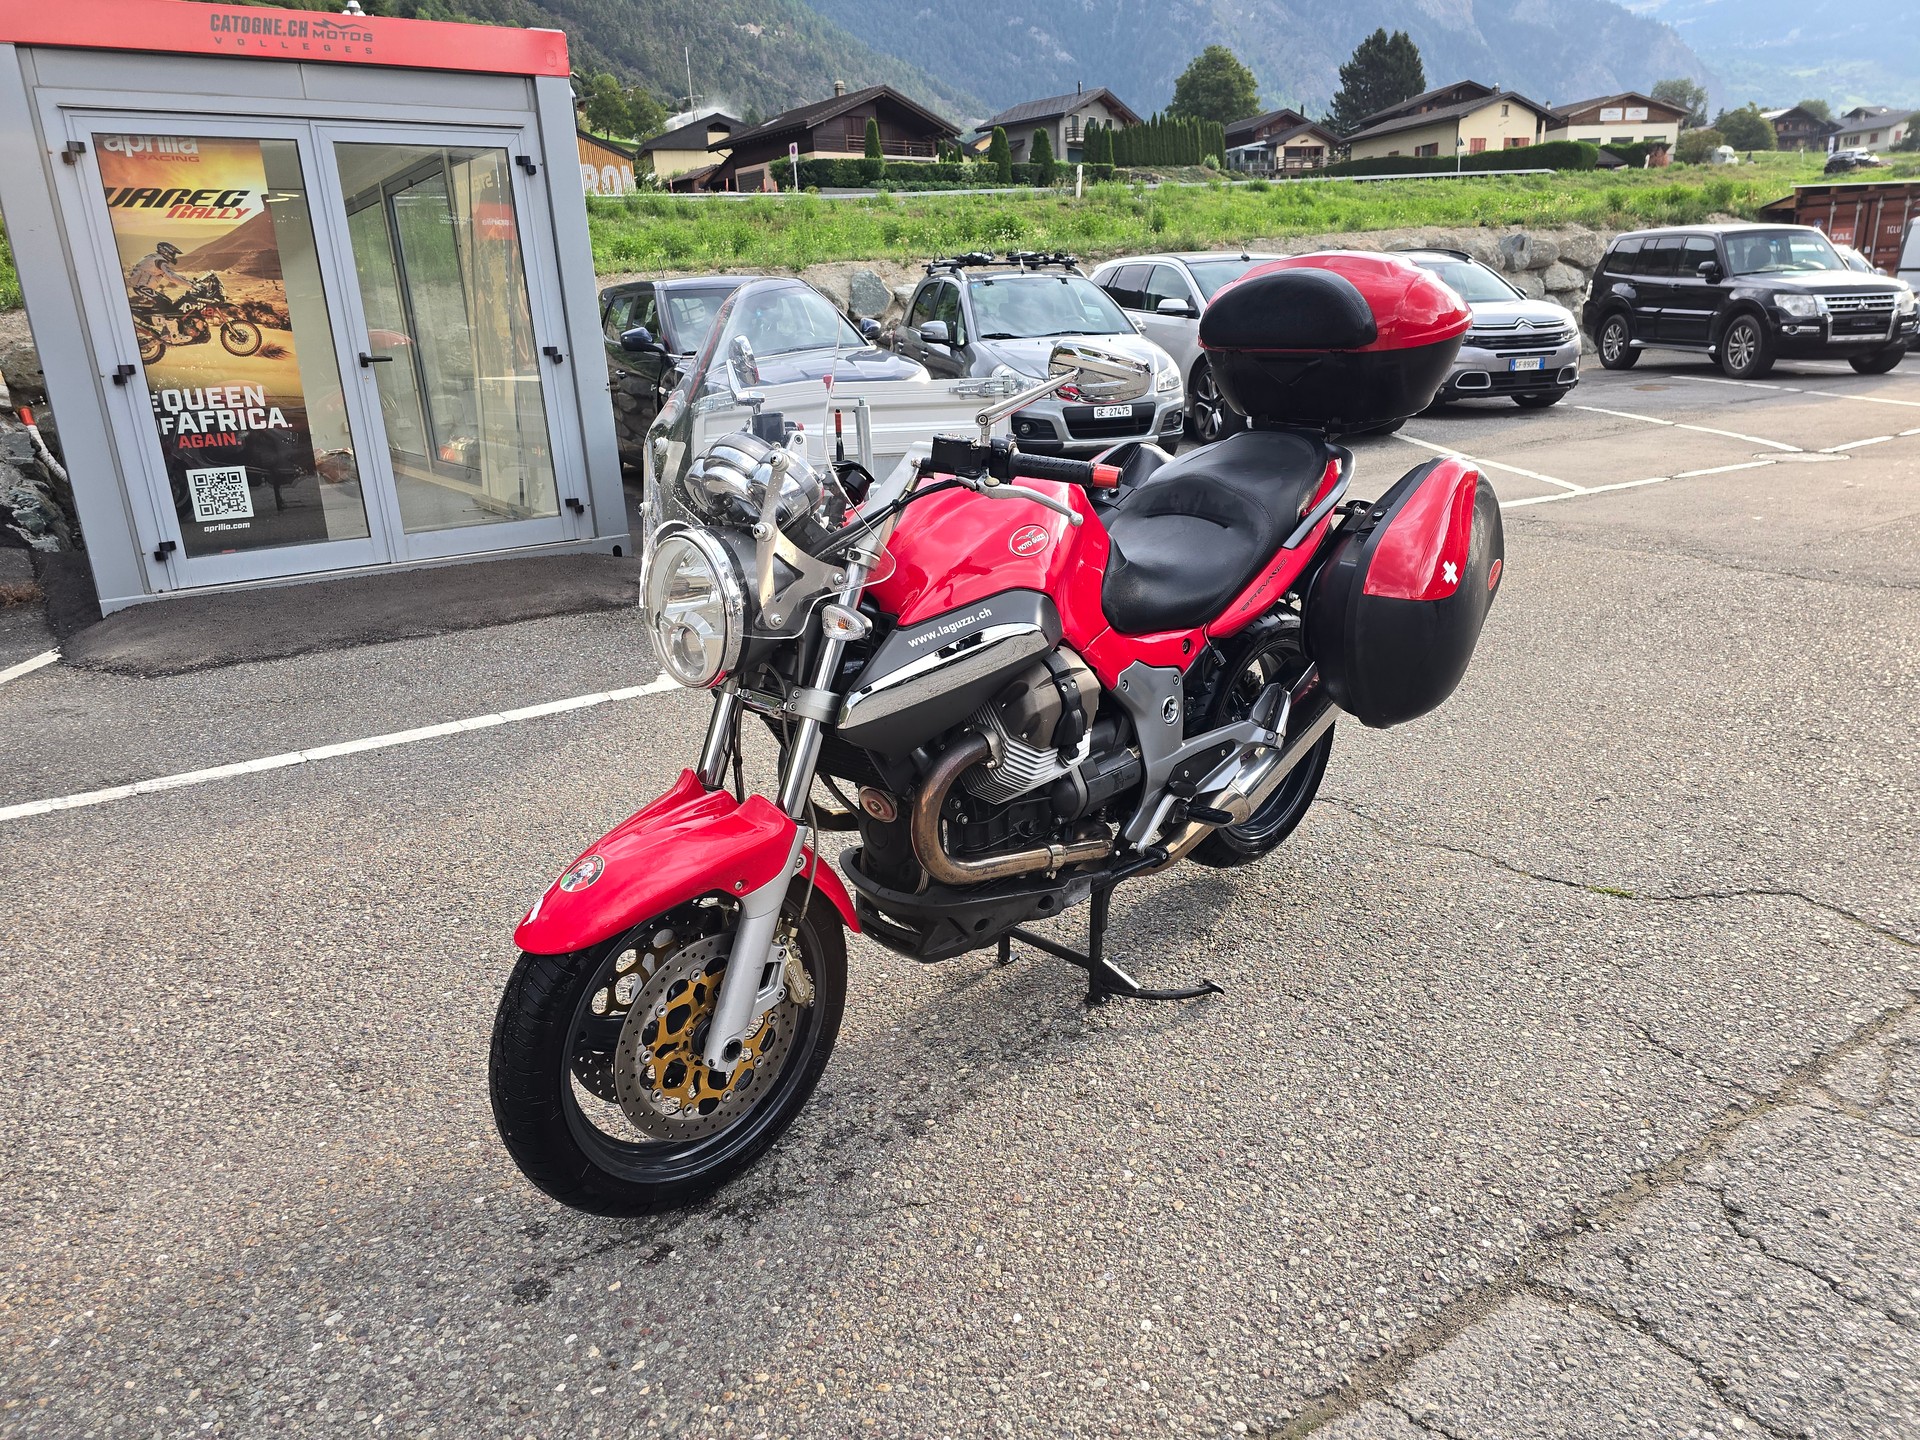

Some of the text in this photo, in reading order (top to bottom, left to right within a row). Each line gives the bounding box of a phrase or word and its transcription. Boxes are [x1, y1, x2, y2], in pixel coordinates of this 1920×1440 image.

[210, 13, 373, 42] CATOGNE.CH MOTOS
[214, 37, 373, 54] VOLLEGES
[165, 204, 251, 219] RALLY
[161, 385, 266, 415] QUEEN
[178, 407, 293, 434] AFRICA.
[179, 432, 242, 449] AGAIN.
[204, 522, 250, 533] aprilia.com
[1017, 540, 1033, 552] MOTO
[907, 607, 993, 649] www.laguzzi.ch
